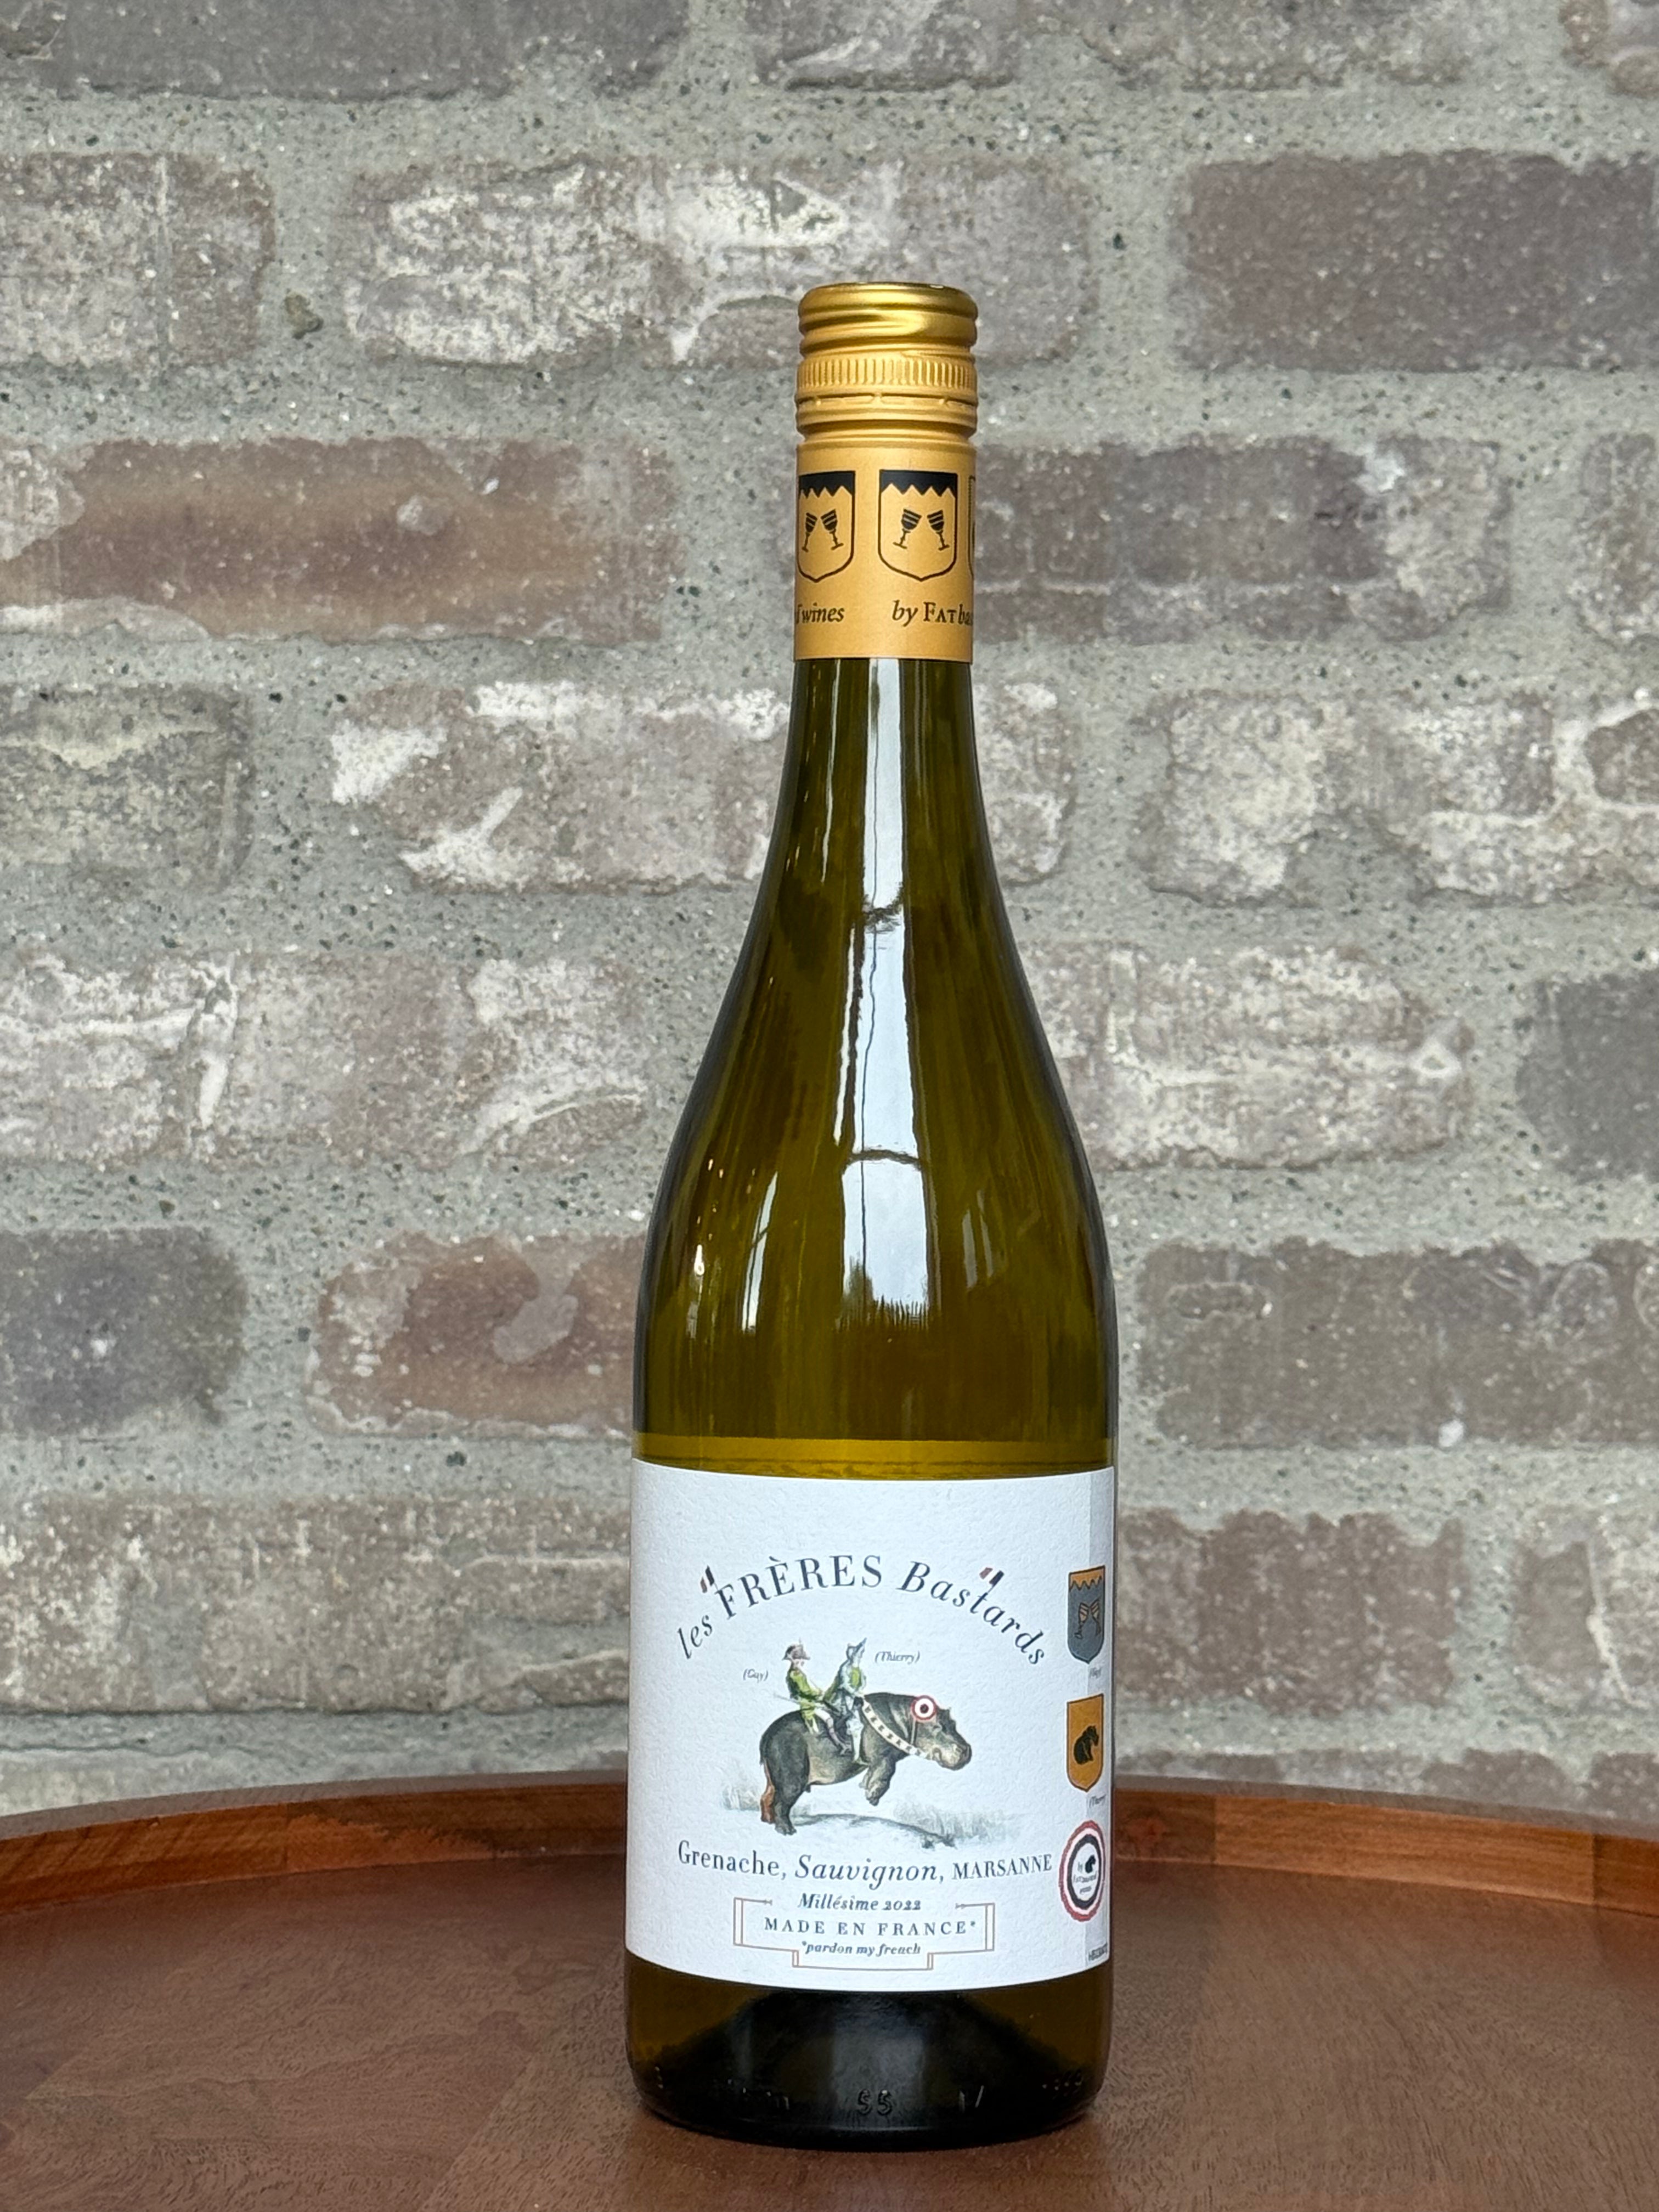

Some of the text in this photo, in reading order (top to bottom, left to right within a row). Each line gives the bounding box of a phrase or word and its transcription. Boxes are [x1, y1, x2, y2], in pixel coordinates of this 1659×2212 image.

[892, 600, 918, 627] by
[676, 1555, 1045, 1664] les FRÈRES Bastards
[678, 1839, 1052, 1891] Grenache, Sauvignon, MARSANNE
[797, 1892, 921, 1911] Millésime 2022
[764, 1917, 825, 1934] MADE
[837, 1922, 866, 1936] EN
[856, 1946, 875, 1957] my
[876, 1943, 921, 1957] french
